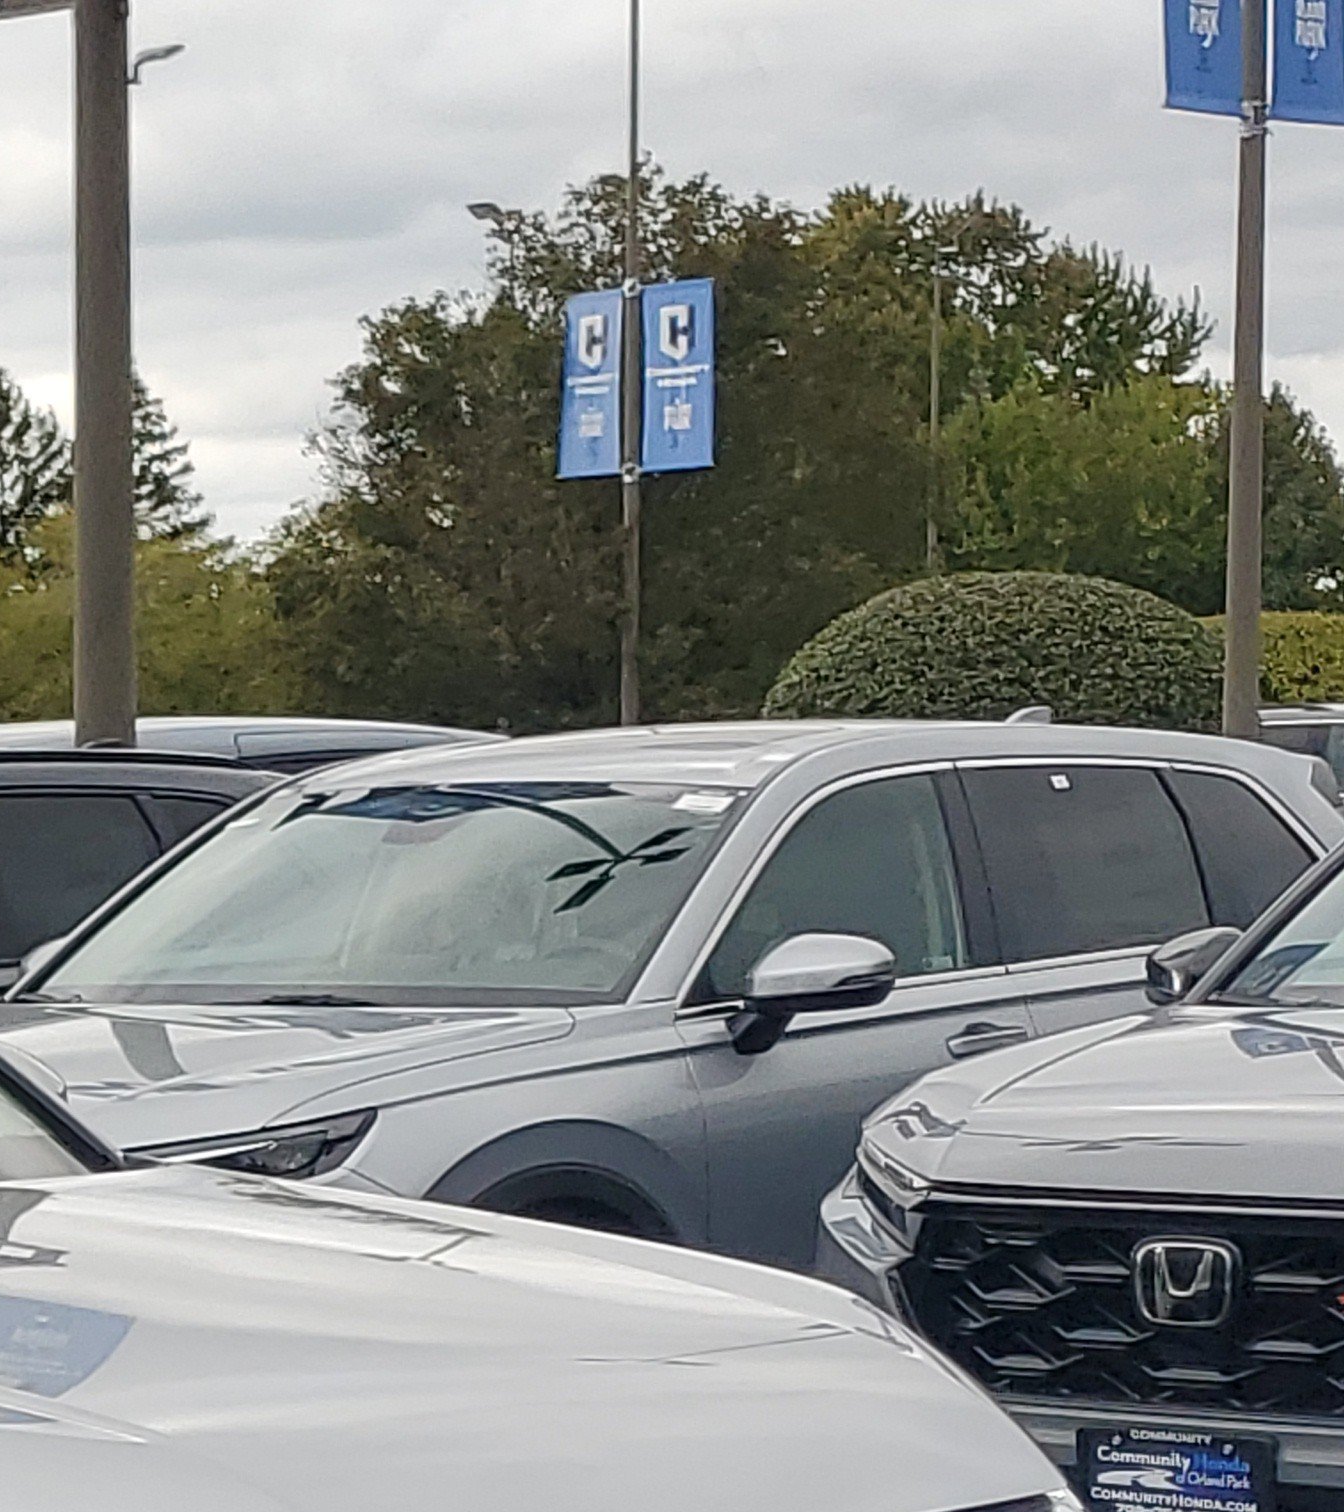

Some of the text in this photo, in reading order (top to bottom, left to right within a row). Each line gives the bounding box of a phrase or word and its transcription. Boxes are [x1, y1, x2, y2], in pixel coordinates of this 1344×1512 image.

[1130, 1428, 1212, 1446] COMMUNITY
[1097, 1446, 1250, 1474] Community Honda
